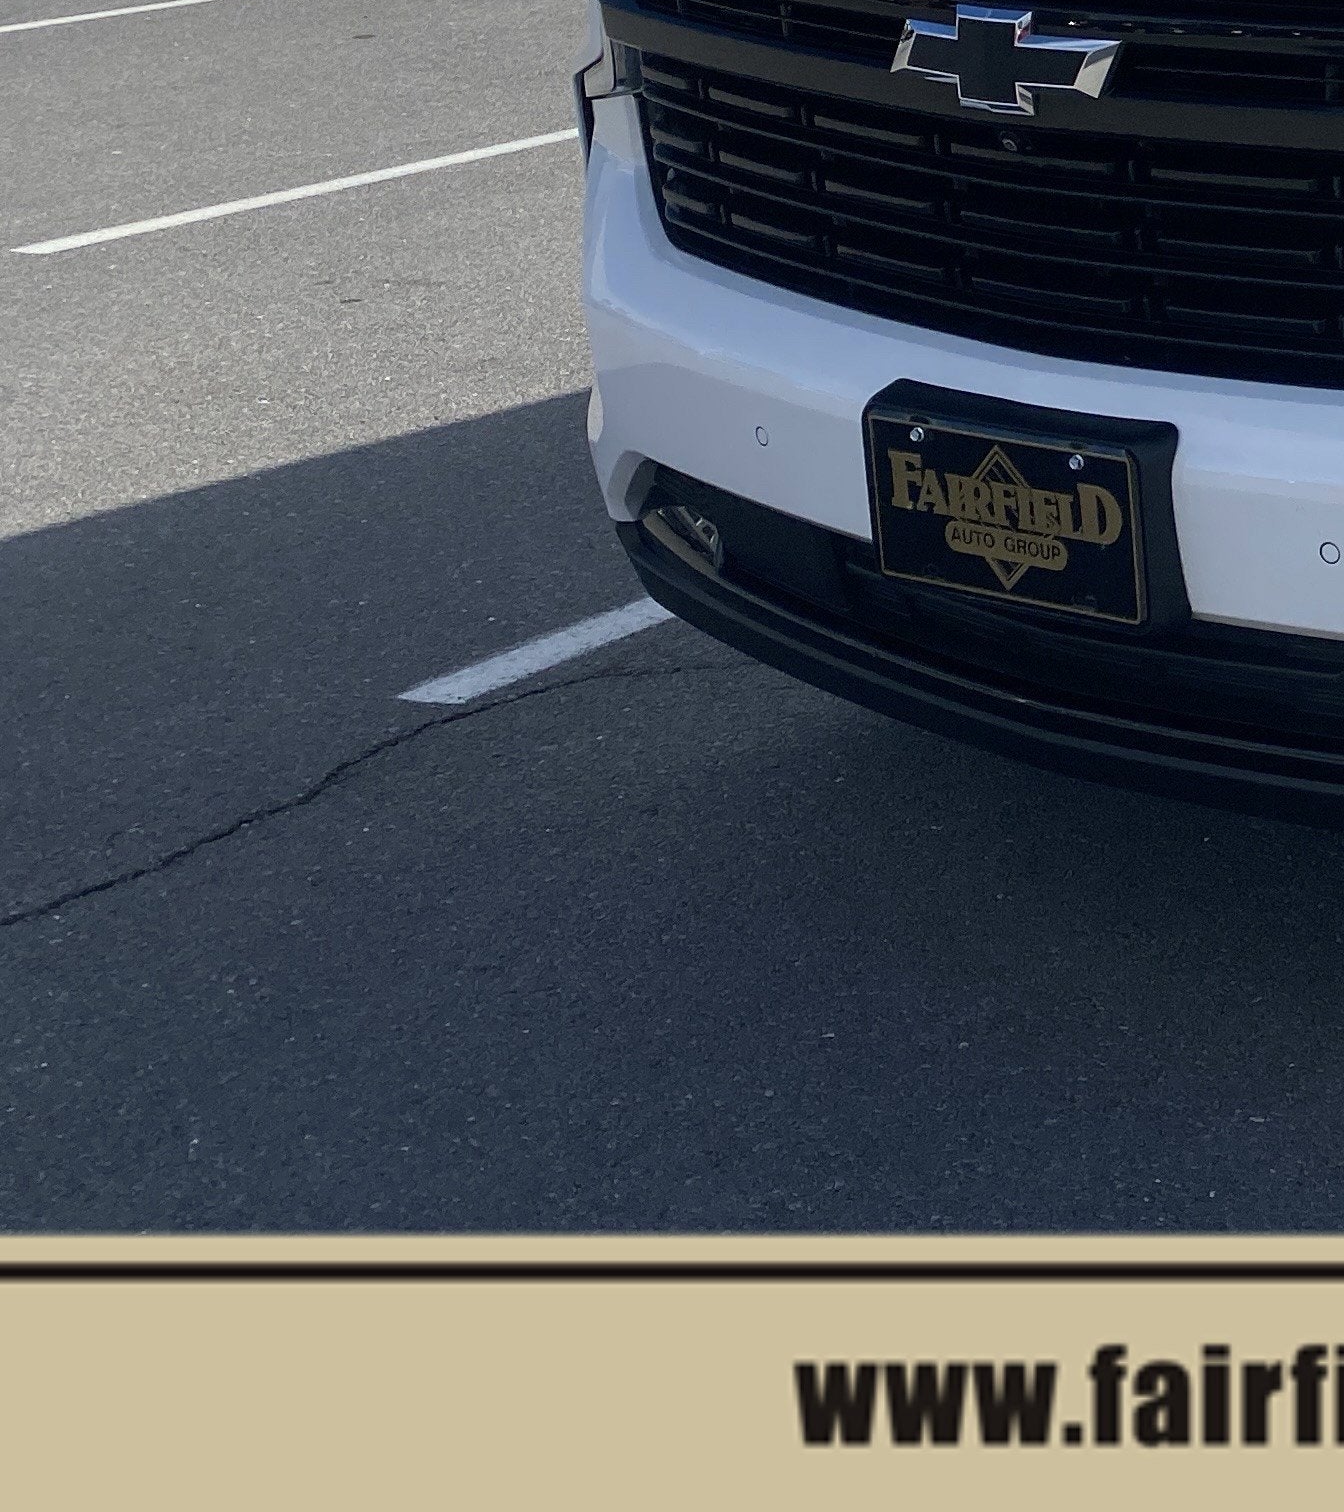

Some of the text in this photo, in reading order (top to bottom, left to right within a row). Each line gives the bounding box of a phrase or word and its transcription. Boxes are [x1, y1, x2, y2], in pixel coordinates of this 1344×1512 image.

[887, 446, 1123, 546] FAIRFIELD
[950, 526, 1062, 562] AUTO GROUP
